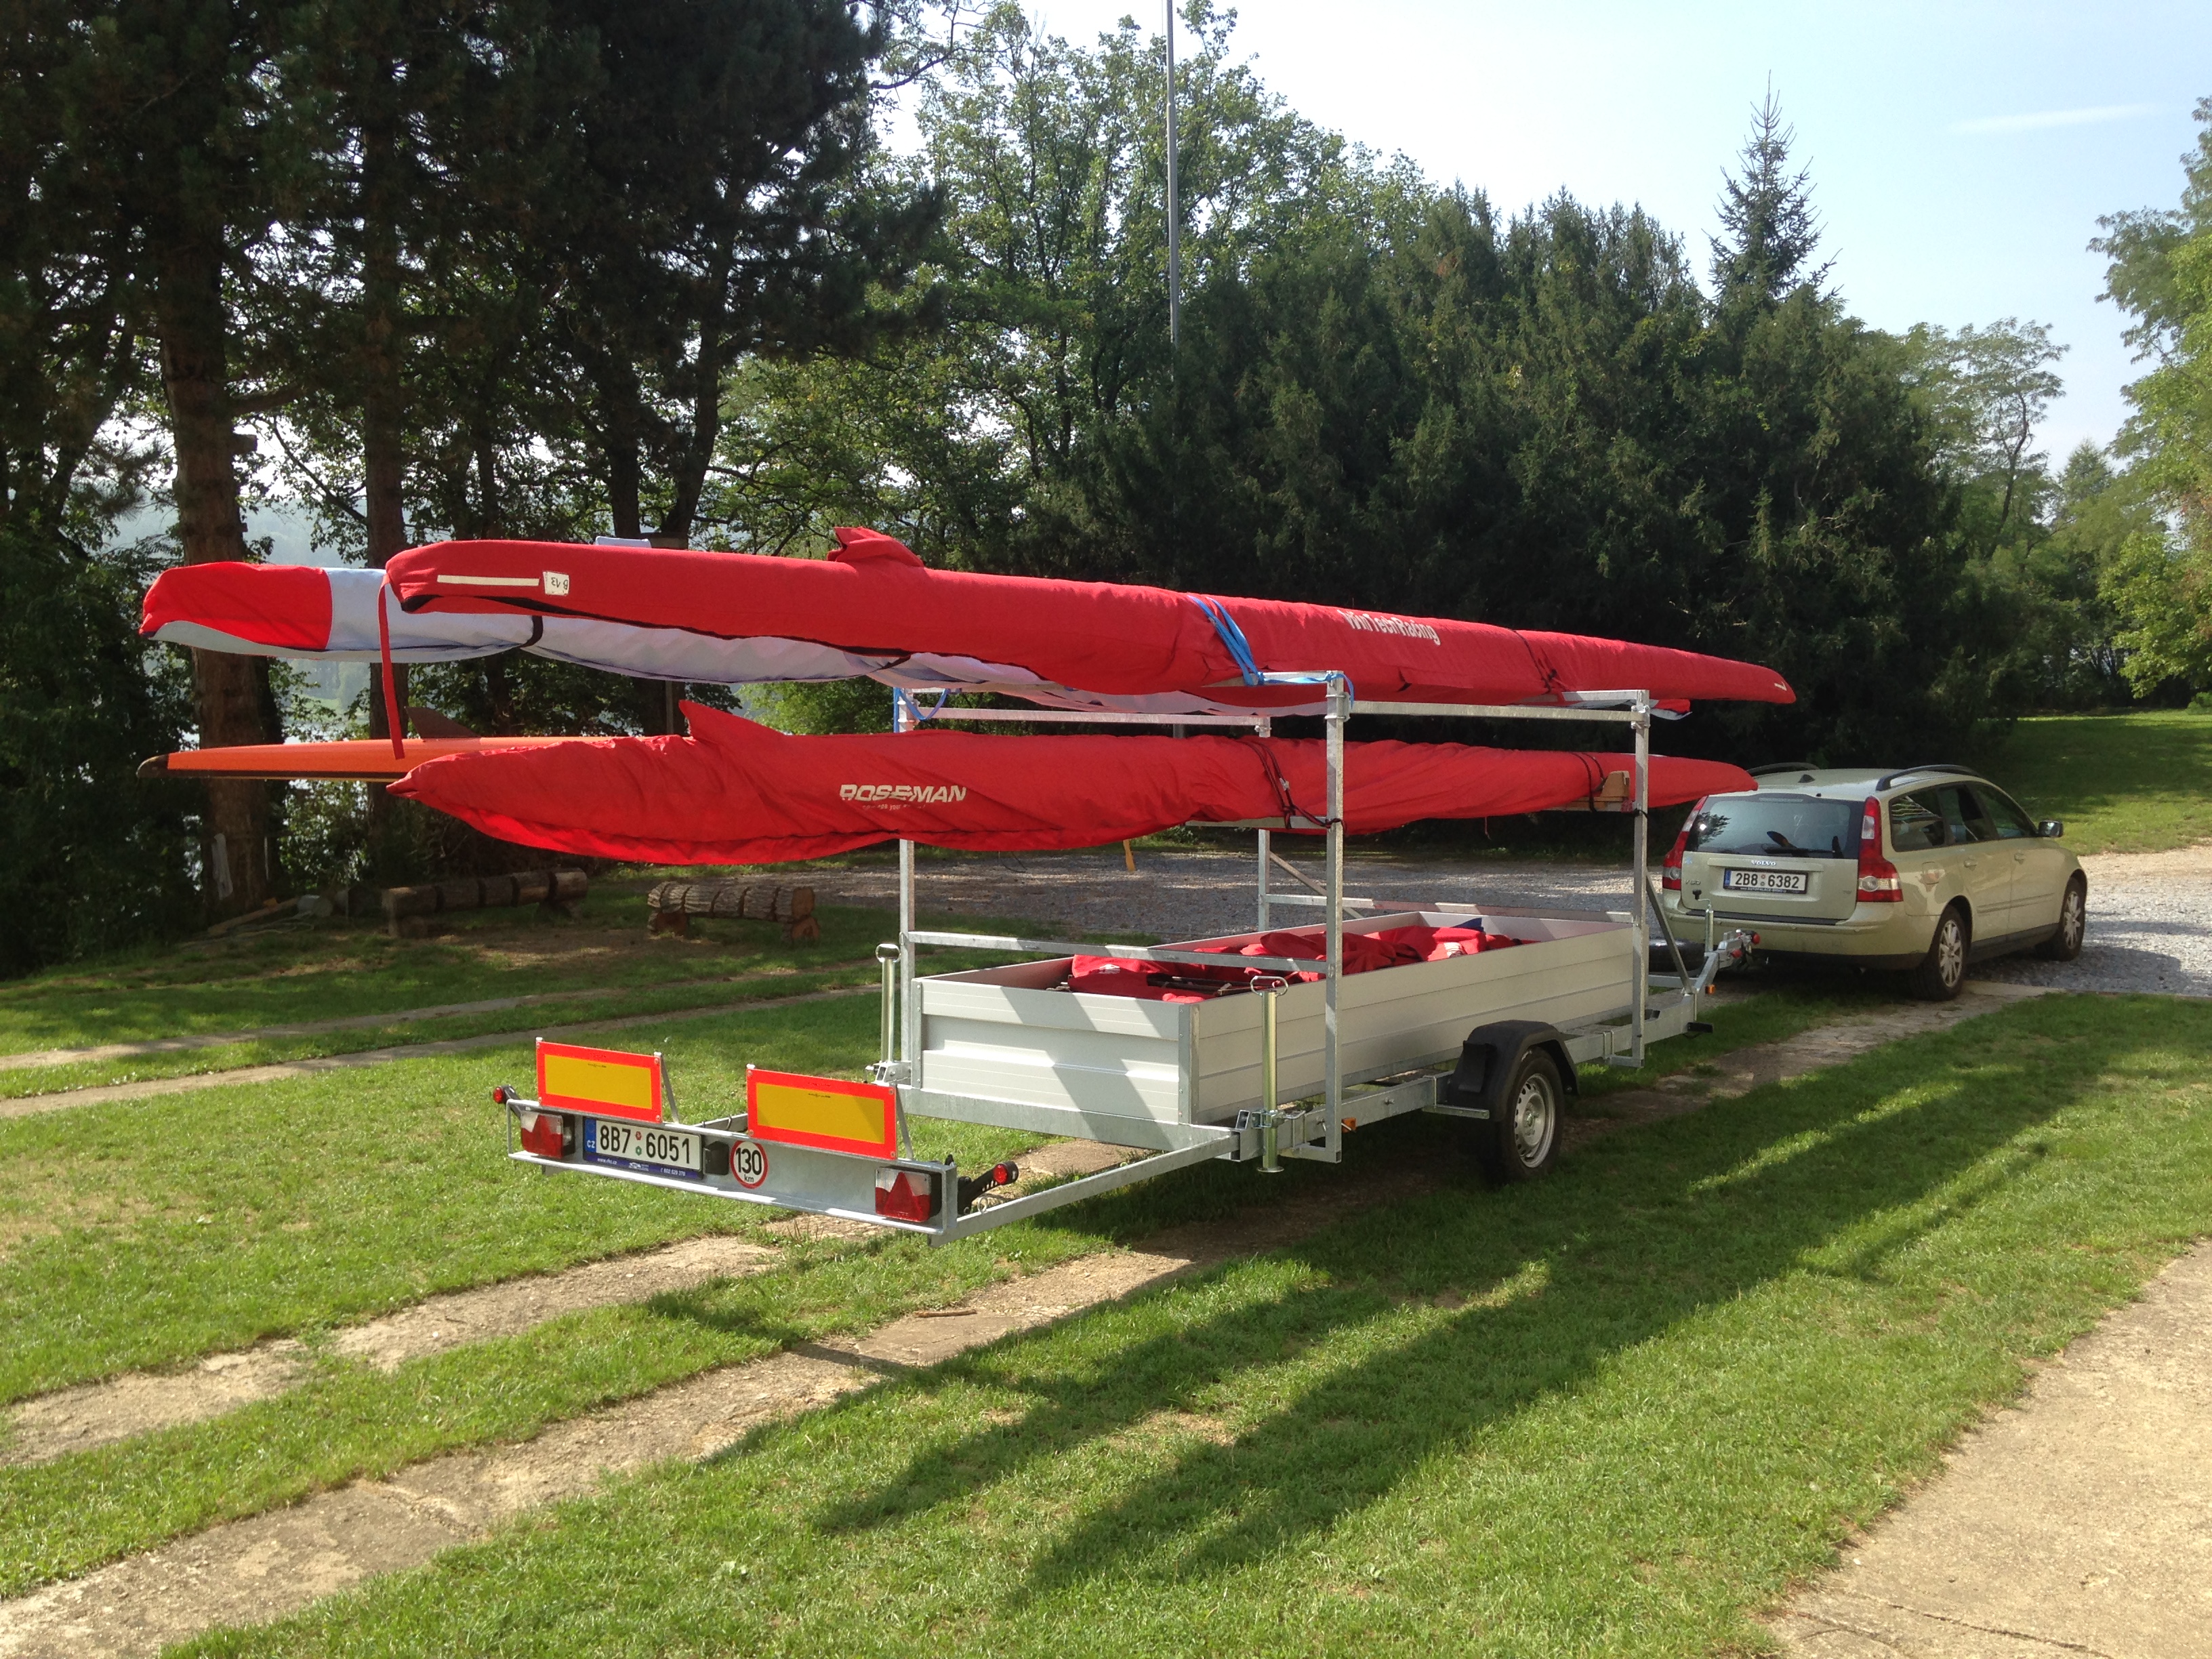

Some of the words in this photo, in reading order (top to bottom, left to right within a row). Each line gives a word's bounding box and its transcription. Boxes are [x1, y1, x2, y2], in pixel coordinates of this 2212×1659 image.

[1735, 872, 1759, 886] 2B8
[1767, 874, 1799, 888] 6382
[587, 1139, 595, 1149] CZ
[600, 1124, 632, 1154] 8B7
[646, 1132, 690, 1164] 6051
[735, 1147, 762, 1176] 130
[744, 1174, 754, 1183] km
